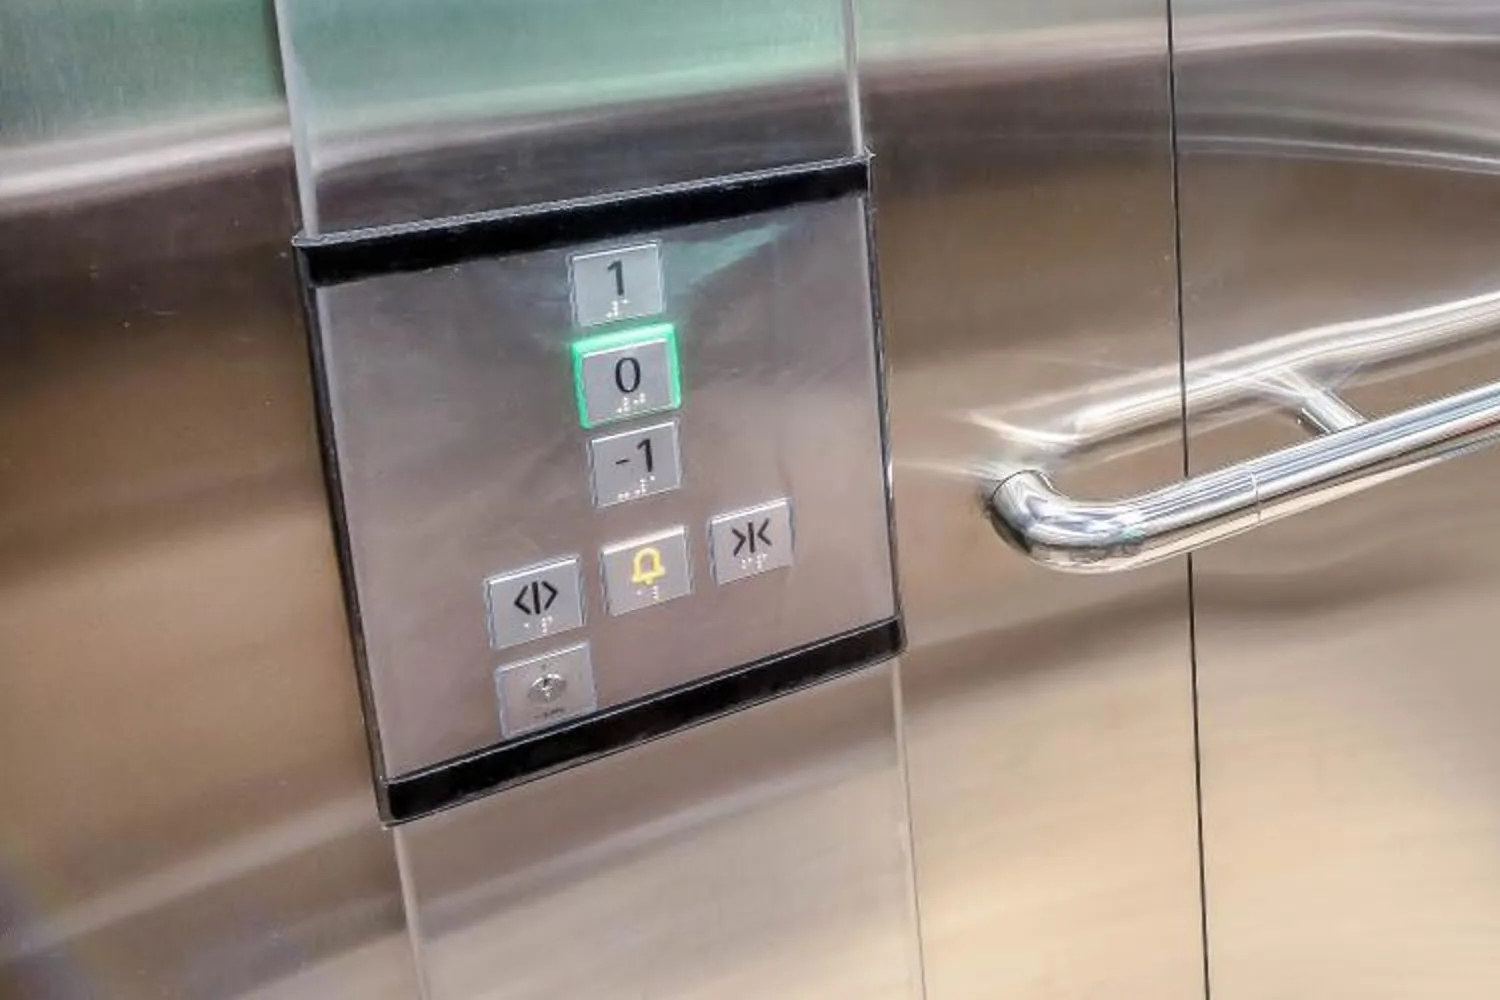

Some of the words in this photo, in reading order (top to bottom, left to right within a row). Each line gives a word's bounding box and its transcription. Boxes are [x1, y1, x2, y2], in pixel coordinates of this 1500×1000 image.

[607, 259, 625, 296] 1
[615, 357, 642, 393] 0
[616, 437, 653, 473] -1
